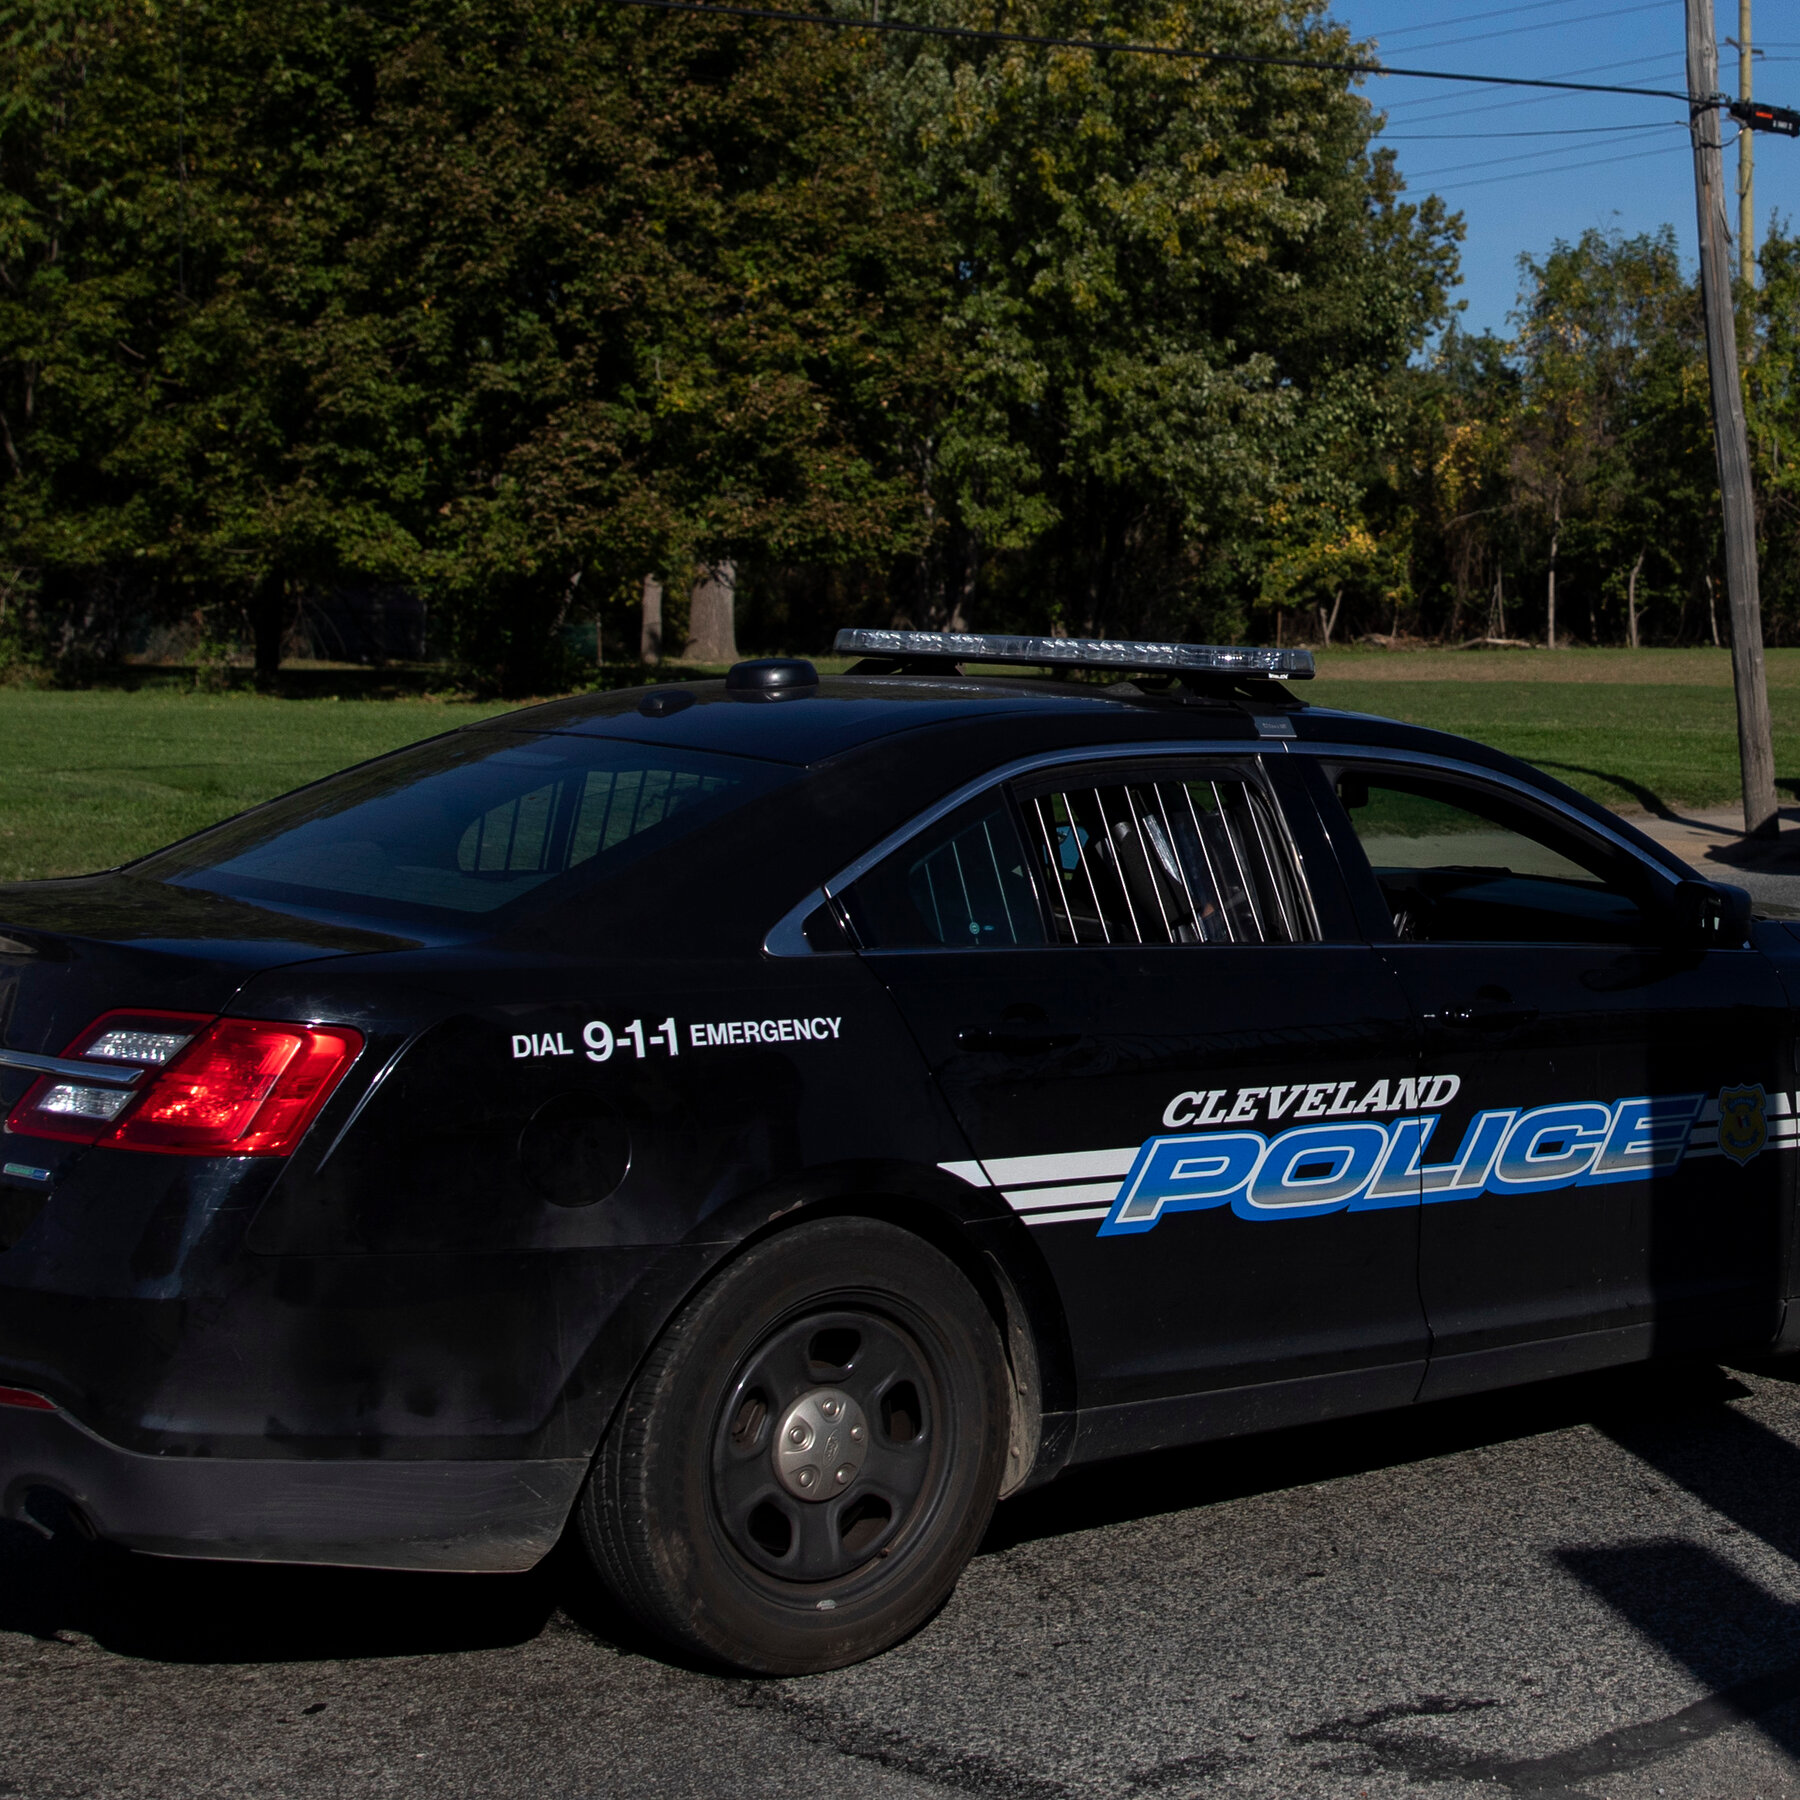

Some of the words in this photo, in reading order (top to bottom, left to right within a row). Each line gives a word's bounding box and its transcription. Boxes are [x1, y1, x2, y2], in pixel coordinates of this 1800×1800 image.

[512, 1033, 573, 1058] DIAL
[583, 1018, 678, 1061] 9-1-1
[690, 1017, 841, 1046] EMERGENCY
[1161, 1074, 1461, 1127] CLEVELAND
[1097, 1091, 1707, 1236] POLICE
